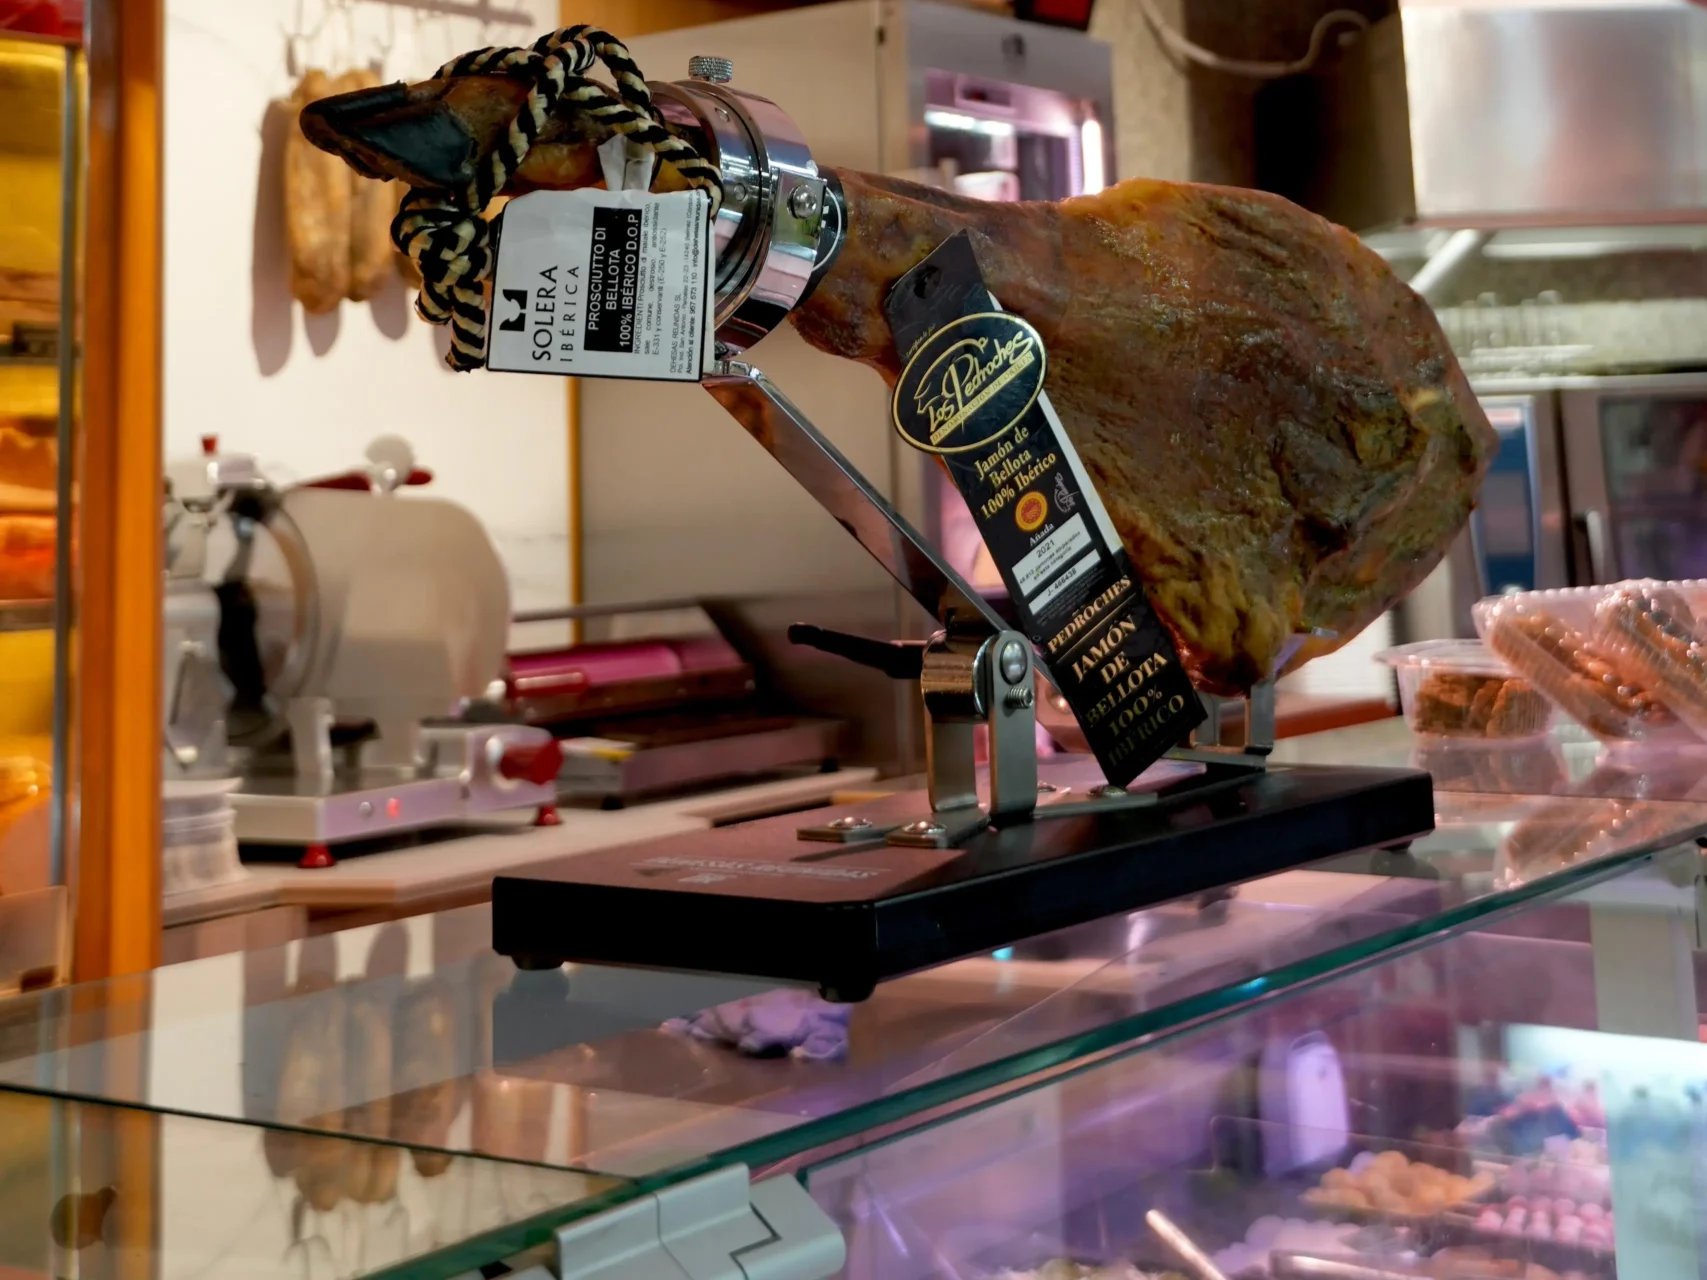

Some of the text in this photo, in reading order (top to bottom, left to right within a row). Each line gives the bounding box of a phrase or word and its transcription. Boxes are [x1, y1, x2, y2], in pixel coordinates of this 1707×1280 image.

[588, 227, 606, 331] PROSCIUTTO DI
[605, 249, 621, 310] BELLOTA
[619, 214, 640, 347] 100% IBÉRICO D.O.P
[532, 265, 559, 361] SOLERA
[559, 266, 580, 363] IBÉRICA
[652, 334, 660, 355] E-331
[928, 331, 1034, 433] Los Pedroches
[974, 425, 1030, 481] Jamón de
[980, 452, 1057, 519] 100% Ibérico
[988, 449, 1032, 489] Bellota
[1029, 523, 1055, 547] Añada
[1036, 539, 1055, 558] 2021
[1047, 574, 1132, 654] PEDROCHES
[1072, 614, 1138, 684] JAMÓN
[1100, 651, 1131, 684] DE
[1086, 652, 1169, 728] BELLOTA
[1108, 683, 1163, 738] 100%
